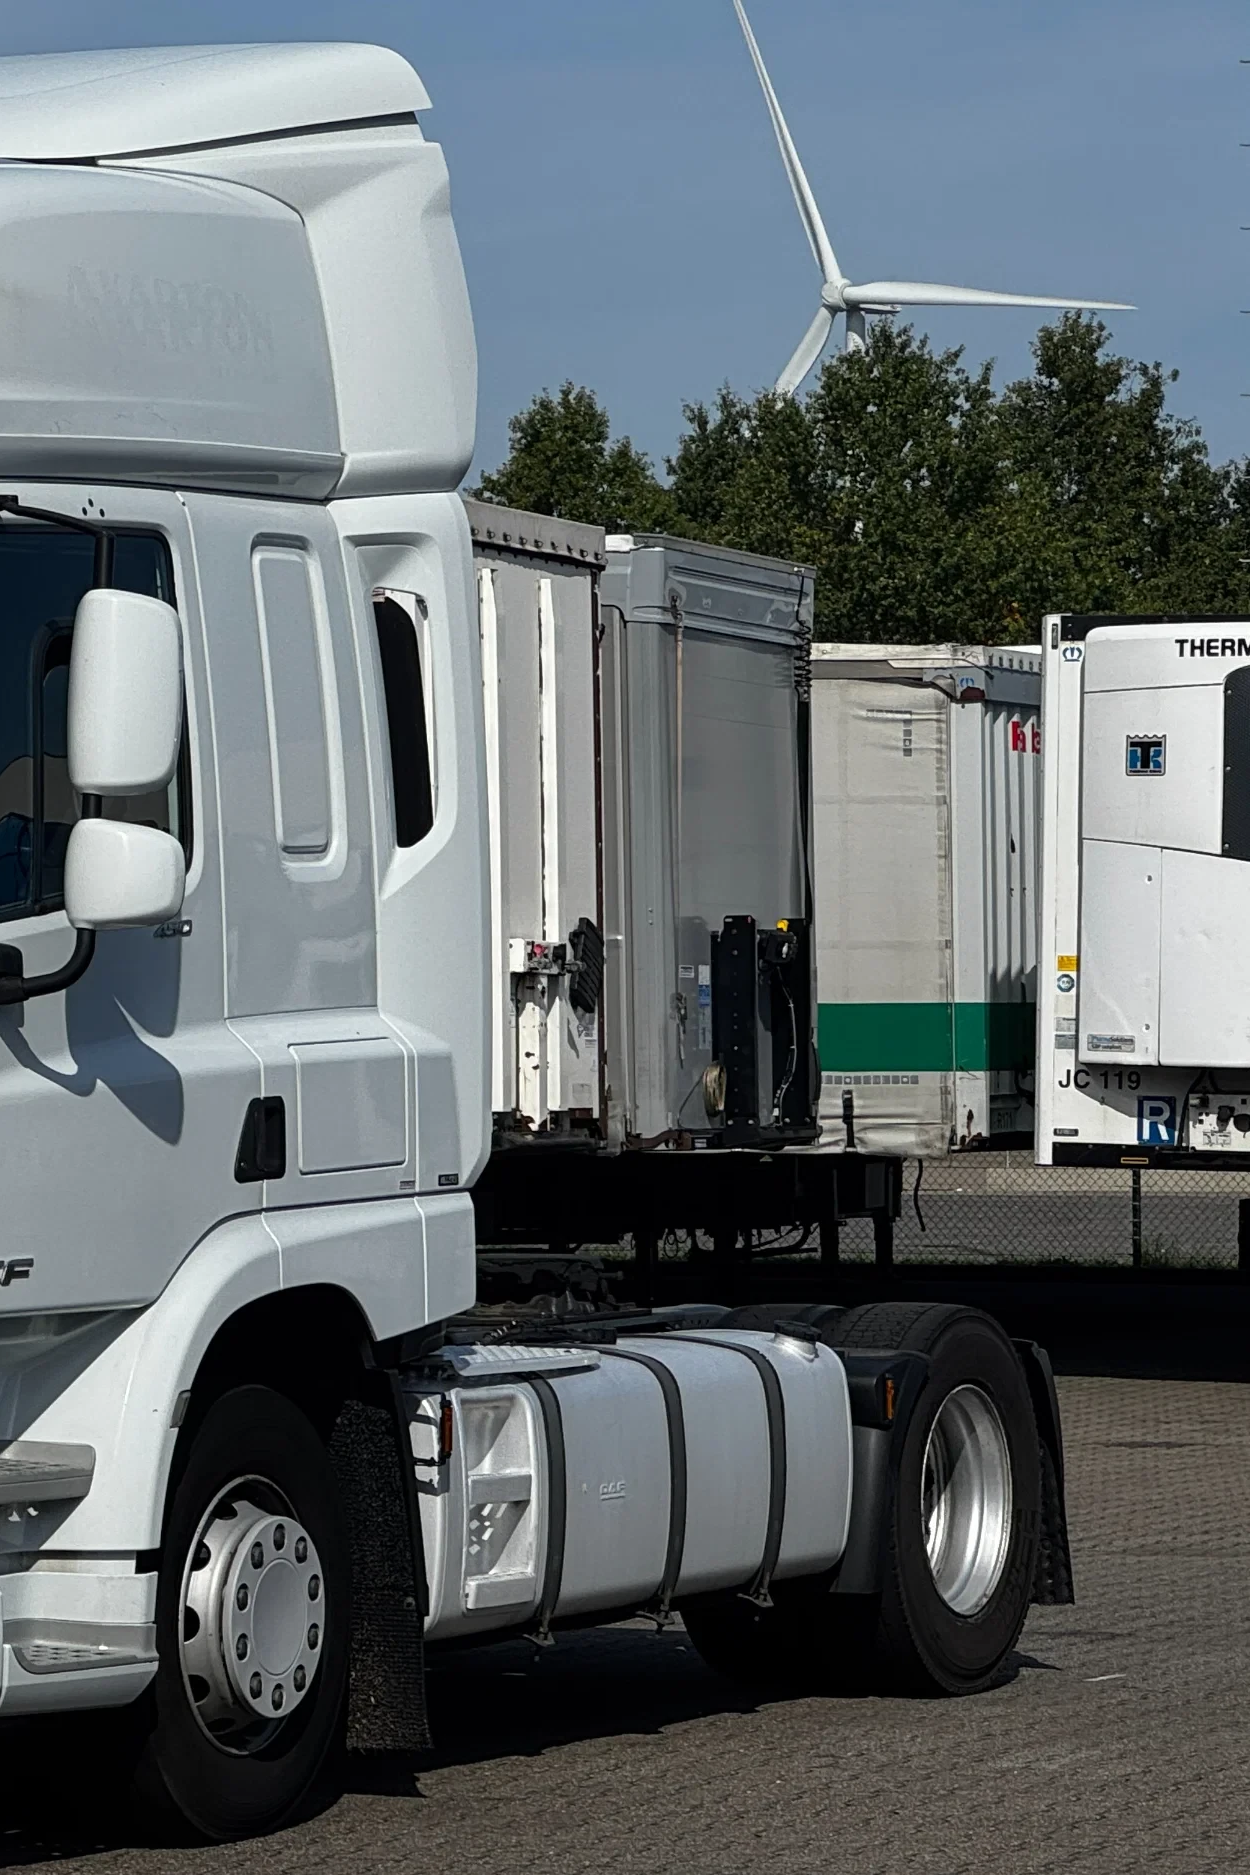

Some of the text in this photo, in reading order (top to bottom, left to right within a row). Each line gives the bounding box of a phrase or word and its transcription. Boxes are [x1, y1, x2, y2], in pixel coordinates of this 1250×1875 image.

[1058, 1069, 1141, 1090] JC 119
[1142, 1101, 1170, 1140] R
